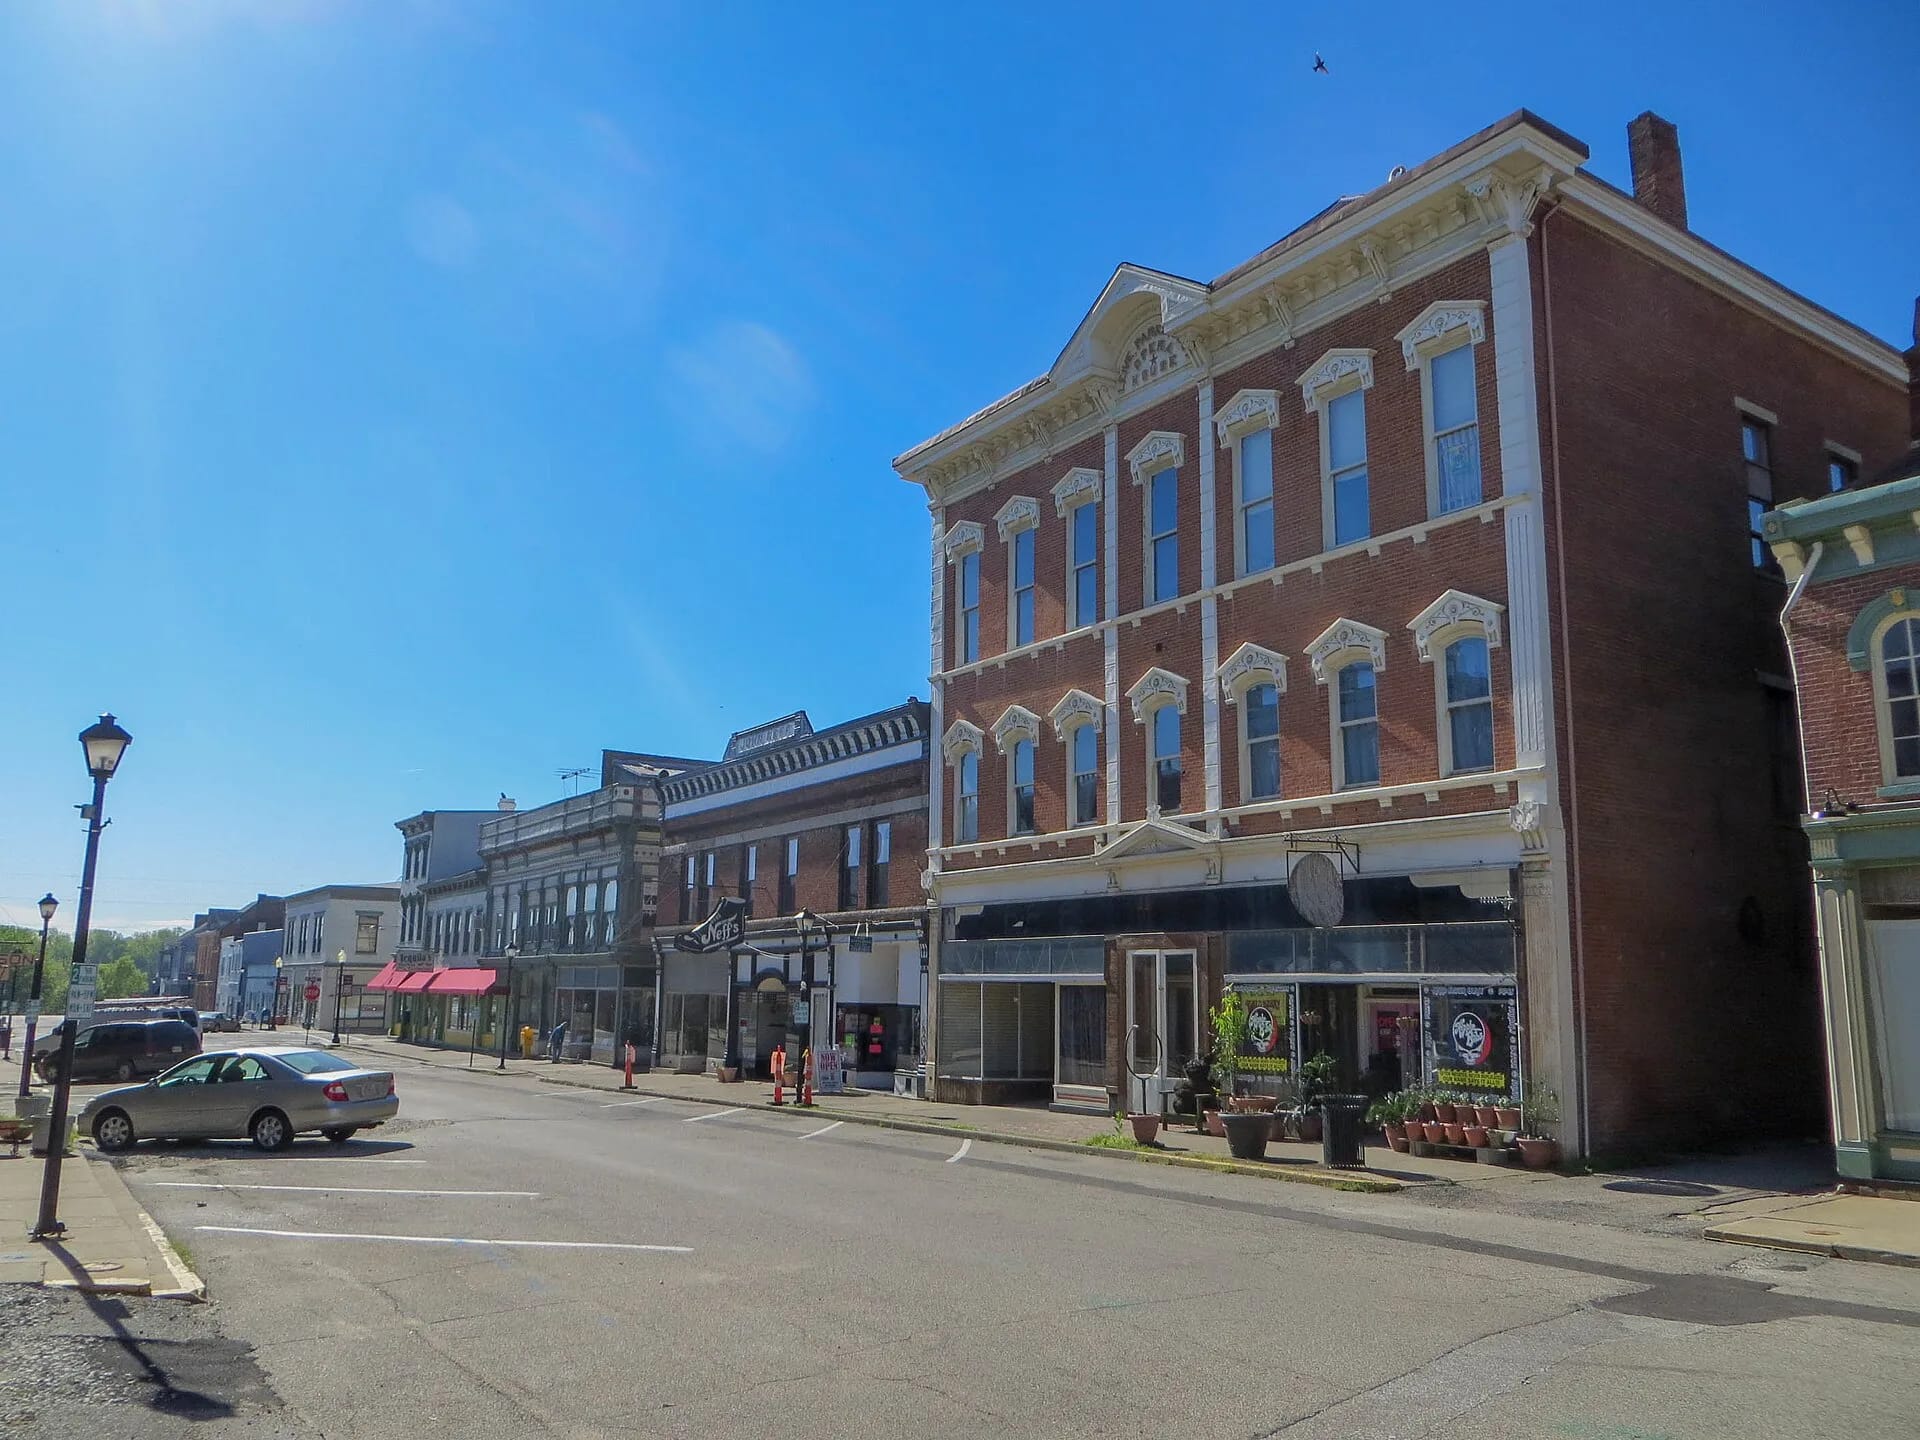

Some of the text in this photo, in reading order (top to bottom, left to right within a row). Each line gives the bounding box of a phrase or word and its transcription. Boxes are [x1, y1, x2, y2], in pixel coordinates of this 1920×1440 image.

[701, 922, 739, 945] Neff's
[304, 988, 320, 996] STOP
[820, 1061, 838, 1070] OPEN
